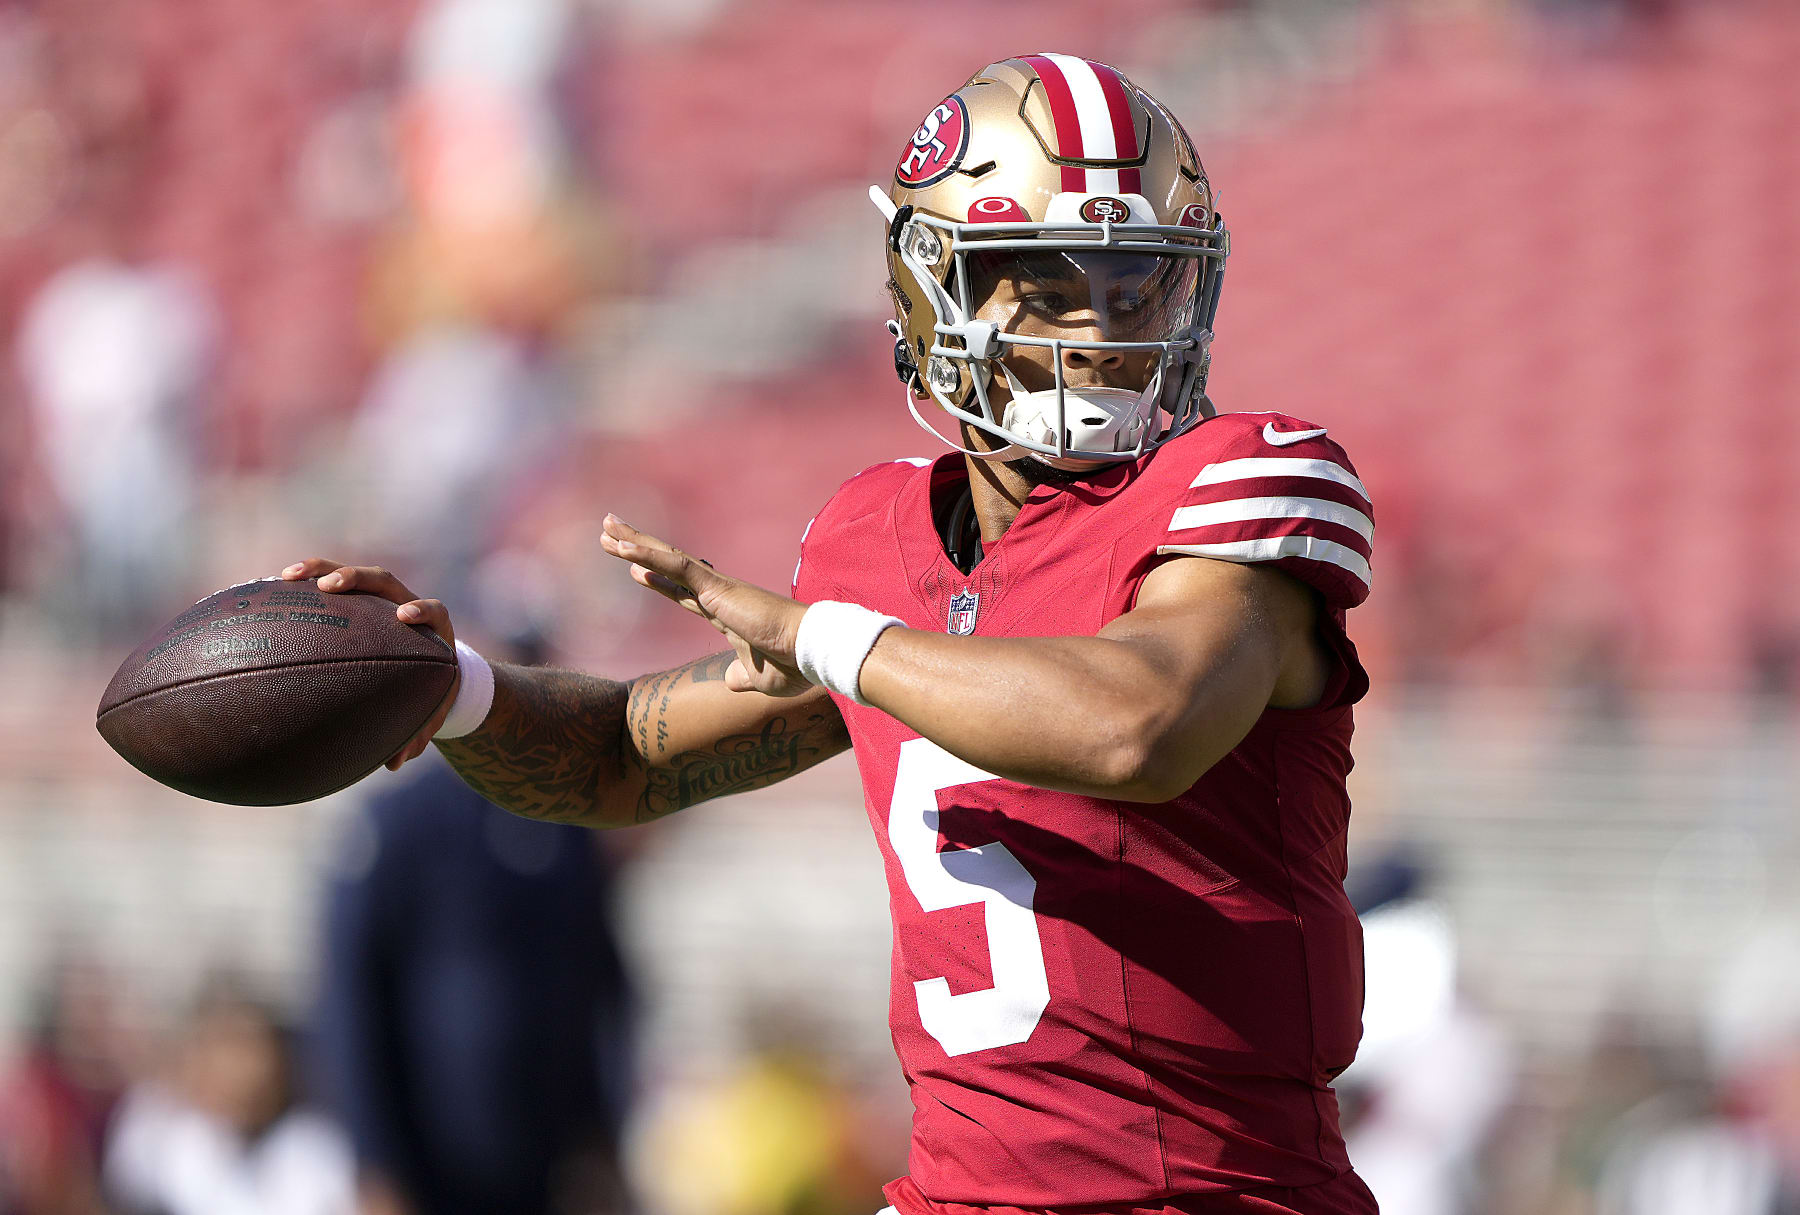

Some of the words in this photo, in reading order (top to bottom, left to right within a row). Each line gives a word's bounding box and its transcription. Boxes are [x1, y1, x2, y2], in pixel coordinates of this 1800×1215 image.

[208, 612, 284, 630] FOOTBALL
[289, 612, 350, 628] LEAGUE
[950, 612, 970, 632] NFL
[657, 720, 668, 753] the
[887, 737, 1052, 1058] 5
